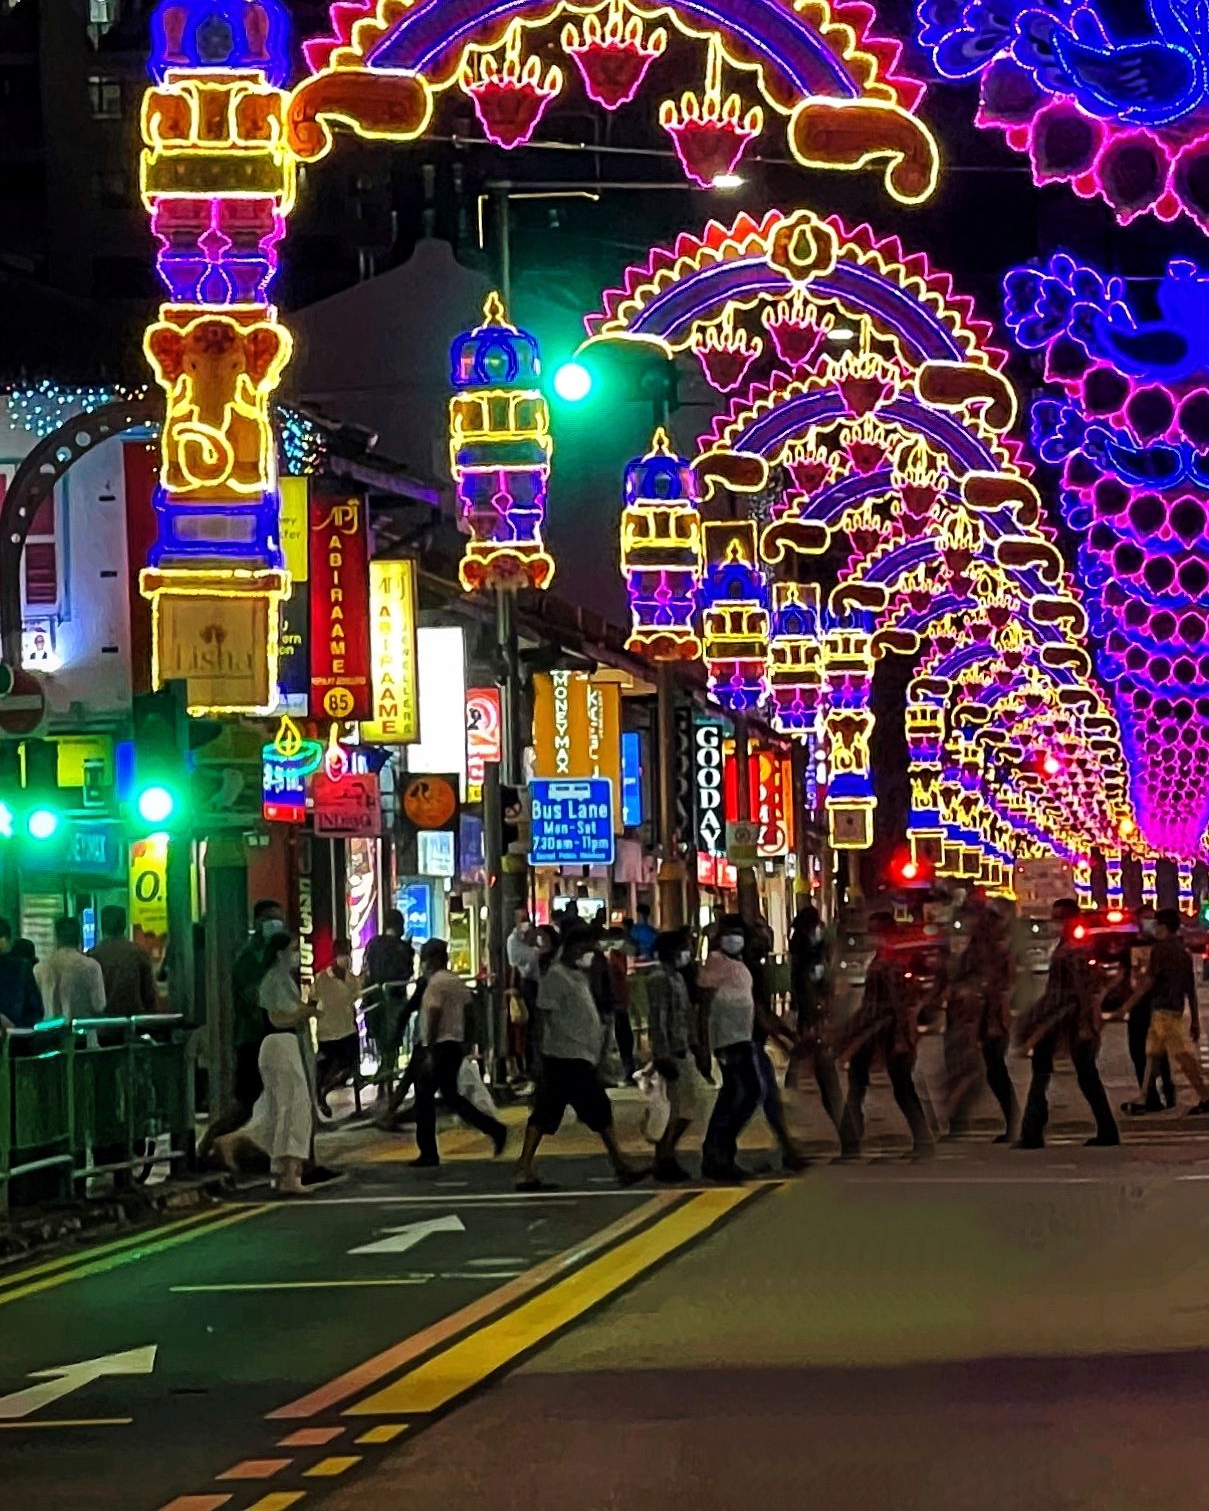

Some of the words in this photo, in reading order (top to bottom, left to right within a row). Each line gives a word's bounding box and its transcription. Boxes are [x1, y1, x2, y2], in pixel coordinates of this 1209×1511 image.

[329, 535, 346, 673] ABIRAAME
[554, 671, 569, 774] MONEYMAX
[532, 799, 562, 820] Bus
[568, 799, 608, 819] Lane
[696, 726, 722, 853] GOODAY
